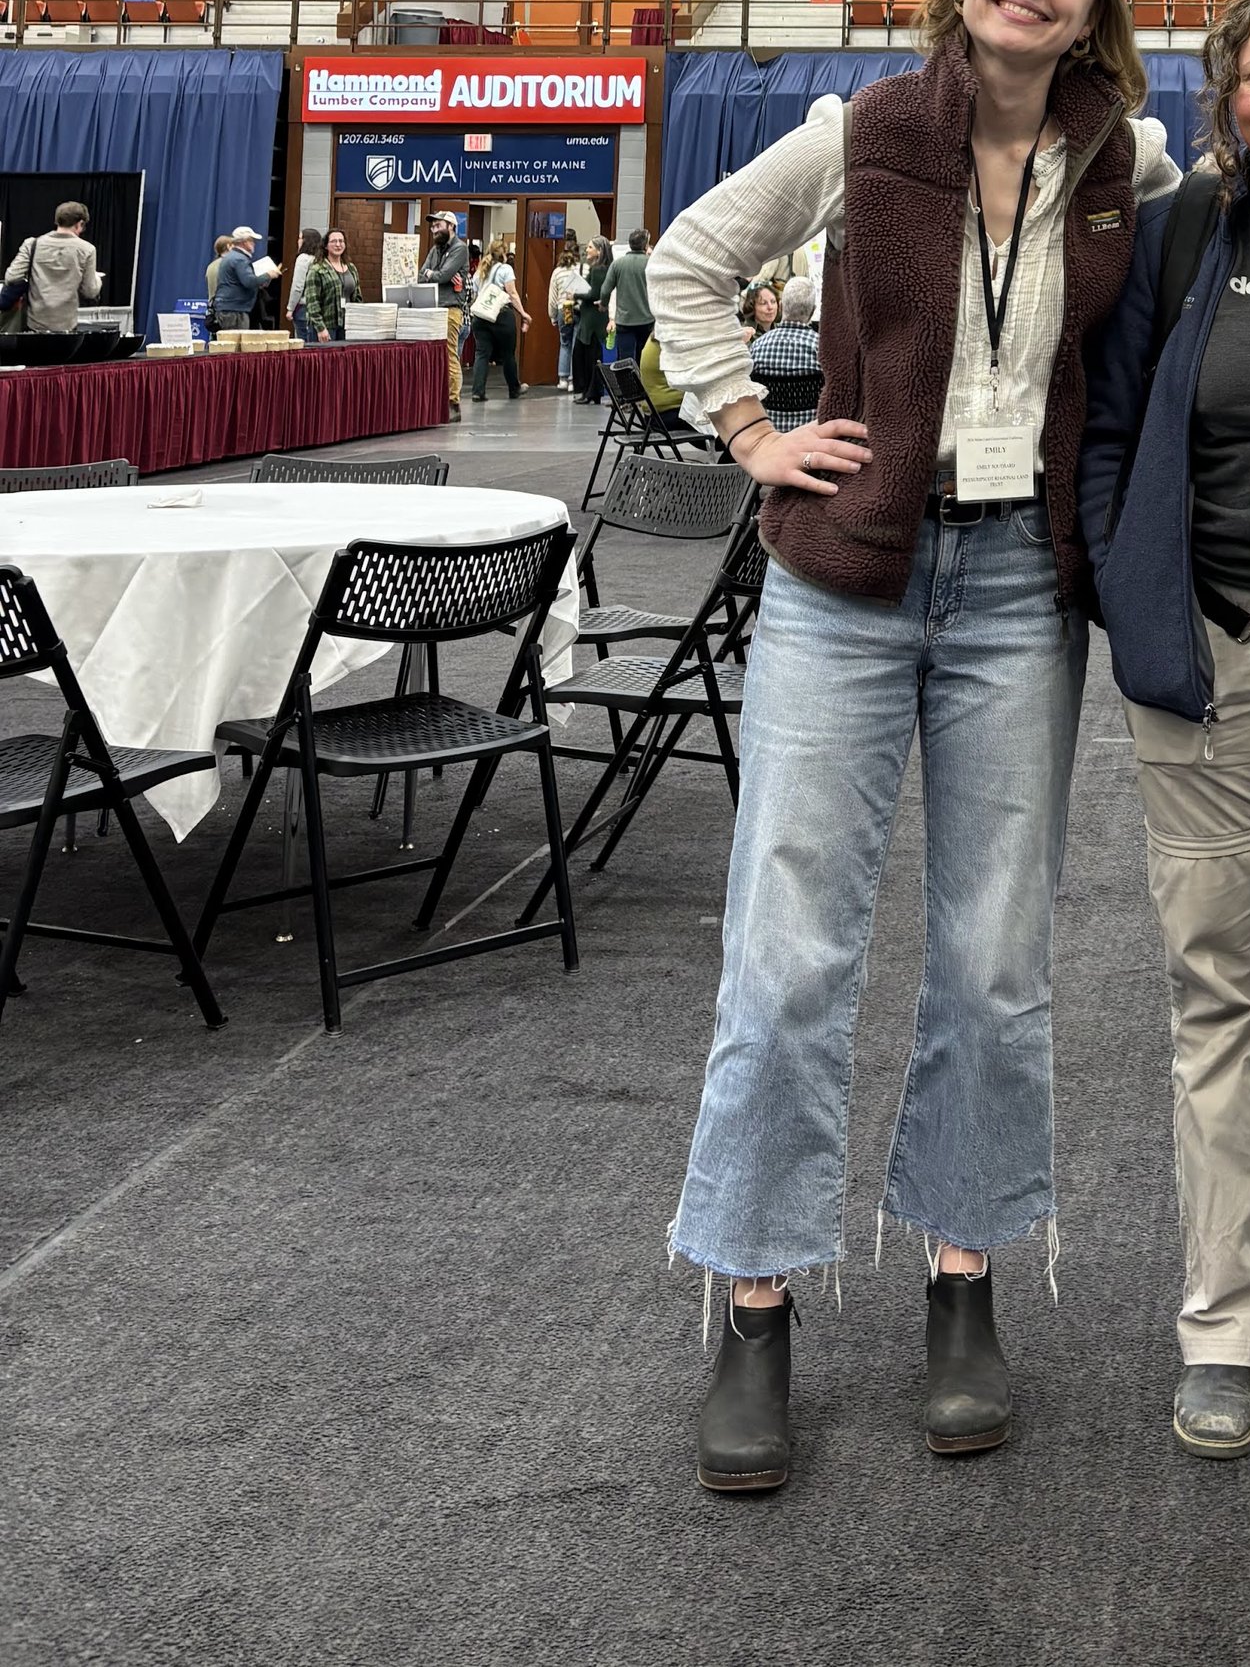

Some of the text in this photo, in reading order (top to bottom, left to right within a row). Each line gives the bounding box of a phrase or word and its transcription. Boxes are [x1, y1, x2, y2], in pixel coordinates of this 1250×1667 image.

[308, 69, 442, 91] Hammond
[448, 75, 641, 107] AUDITORIUM
[313, 95, 436, 108] Lumber Company
[469, 135, 487, 150] EXIT
[566, 136, 609, 145] uma.edu
[398, 160, 457, 183] UMA
[465, 160, 586, 170] UNIVERSITY OF MAINE
[490, 174, 560, 184] AT AUGUSTA
[985, 446, 1007, 454] EMILY
